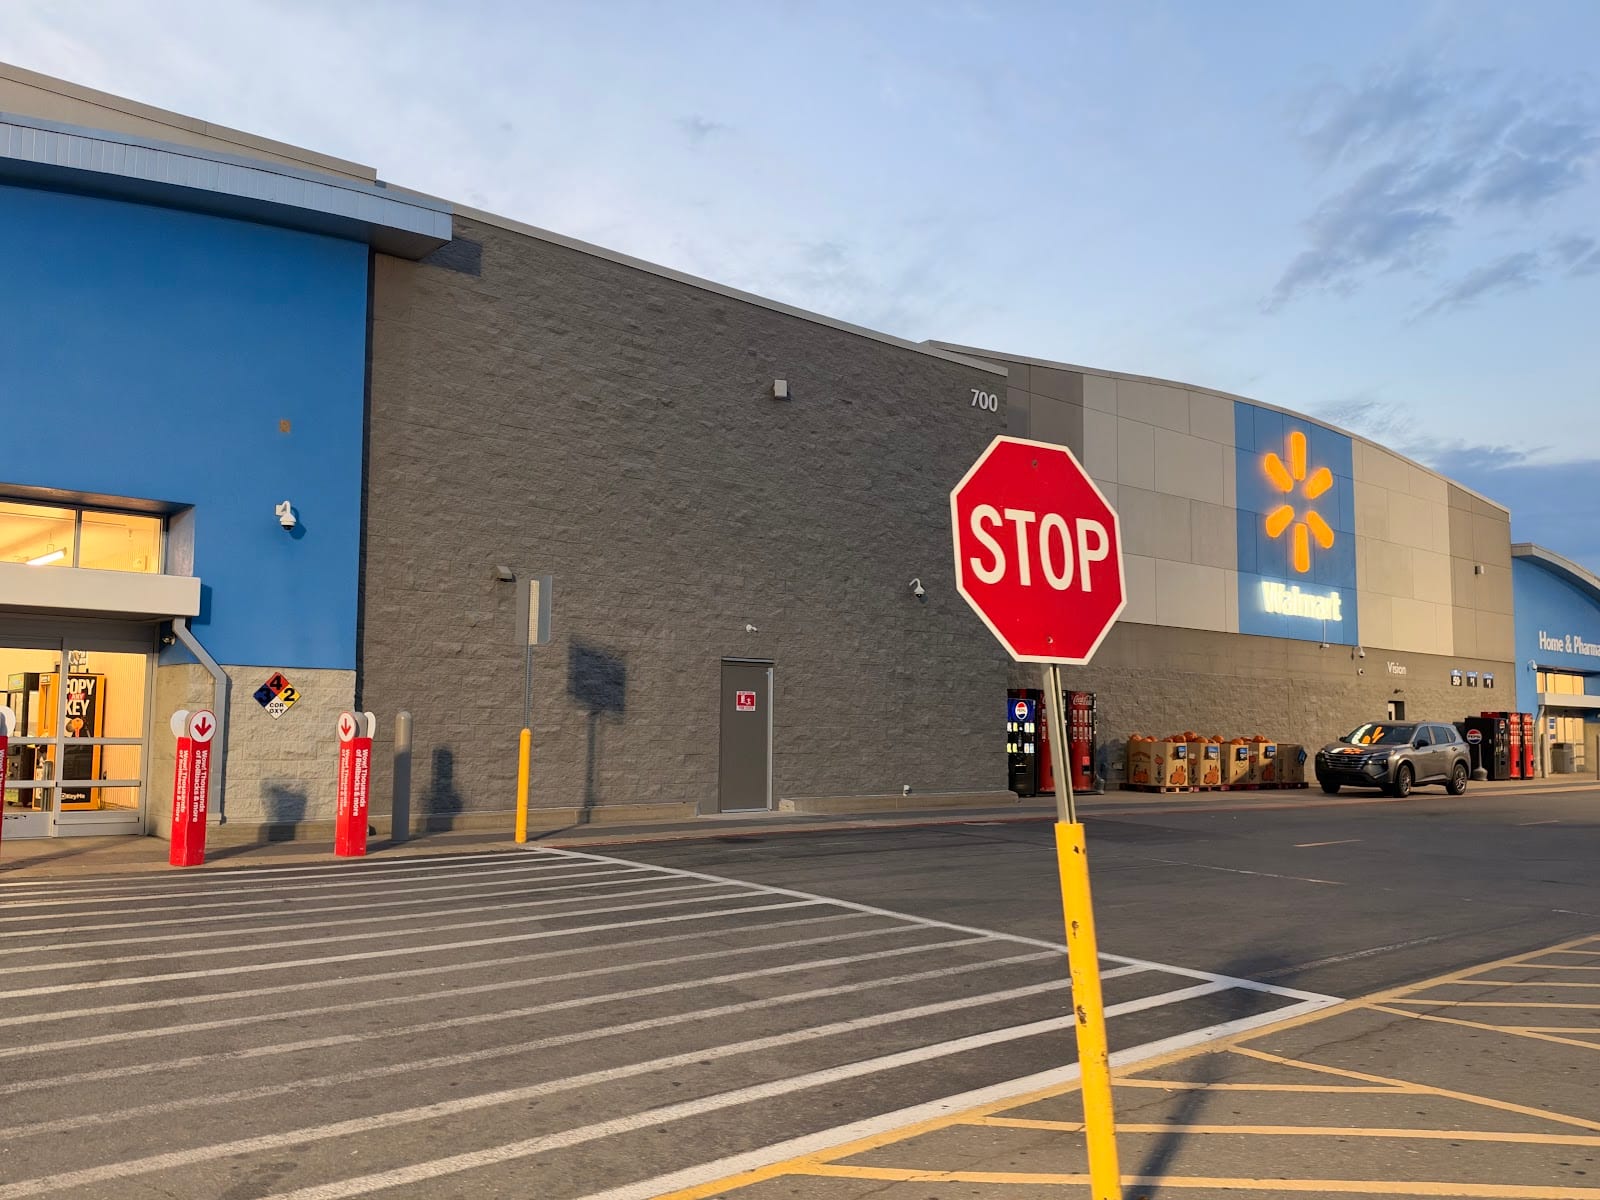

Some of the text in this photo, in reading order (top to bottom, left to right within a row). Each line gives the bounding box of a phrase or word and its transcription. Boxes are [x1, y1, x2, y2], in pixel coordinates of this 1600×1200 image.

[971, 389, 998, 412] 700
[970, 504, 1110, 592] STOP
[1262, 581, 1342, 621] Walmart
[1539, 630, 1600, 656] Home & Pharma
[1387, 661, 1406, 674] Vision
[270, 676, 282, 690] 4
[284, 688, 295, 702] 2
[65, 700, 90, 716] KEY
[356, 749, 362, 757] of
